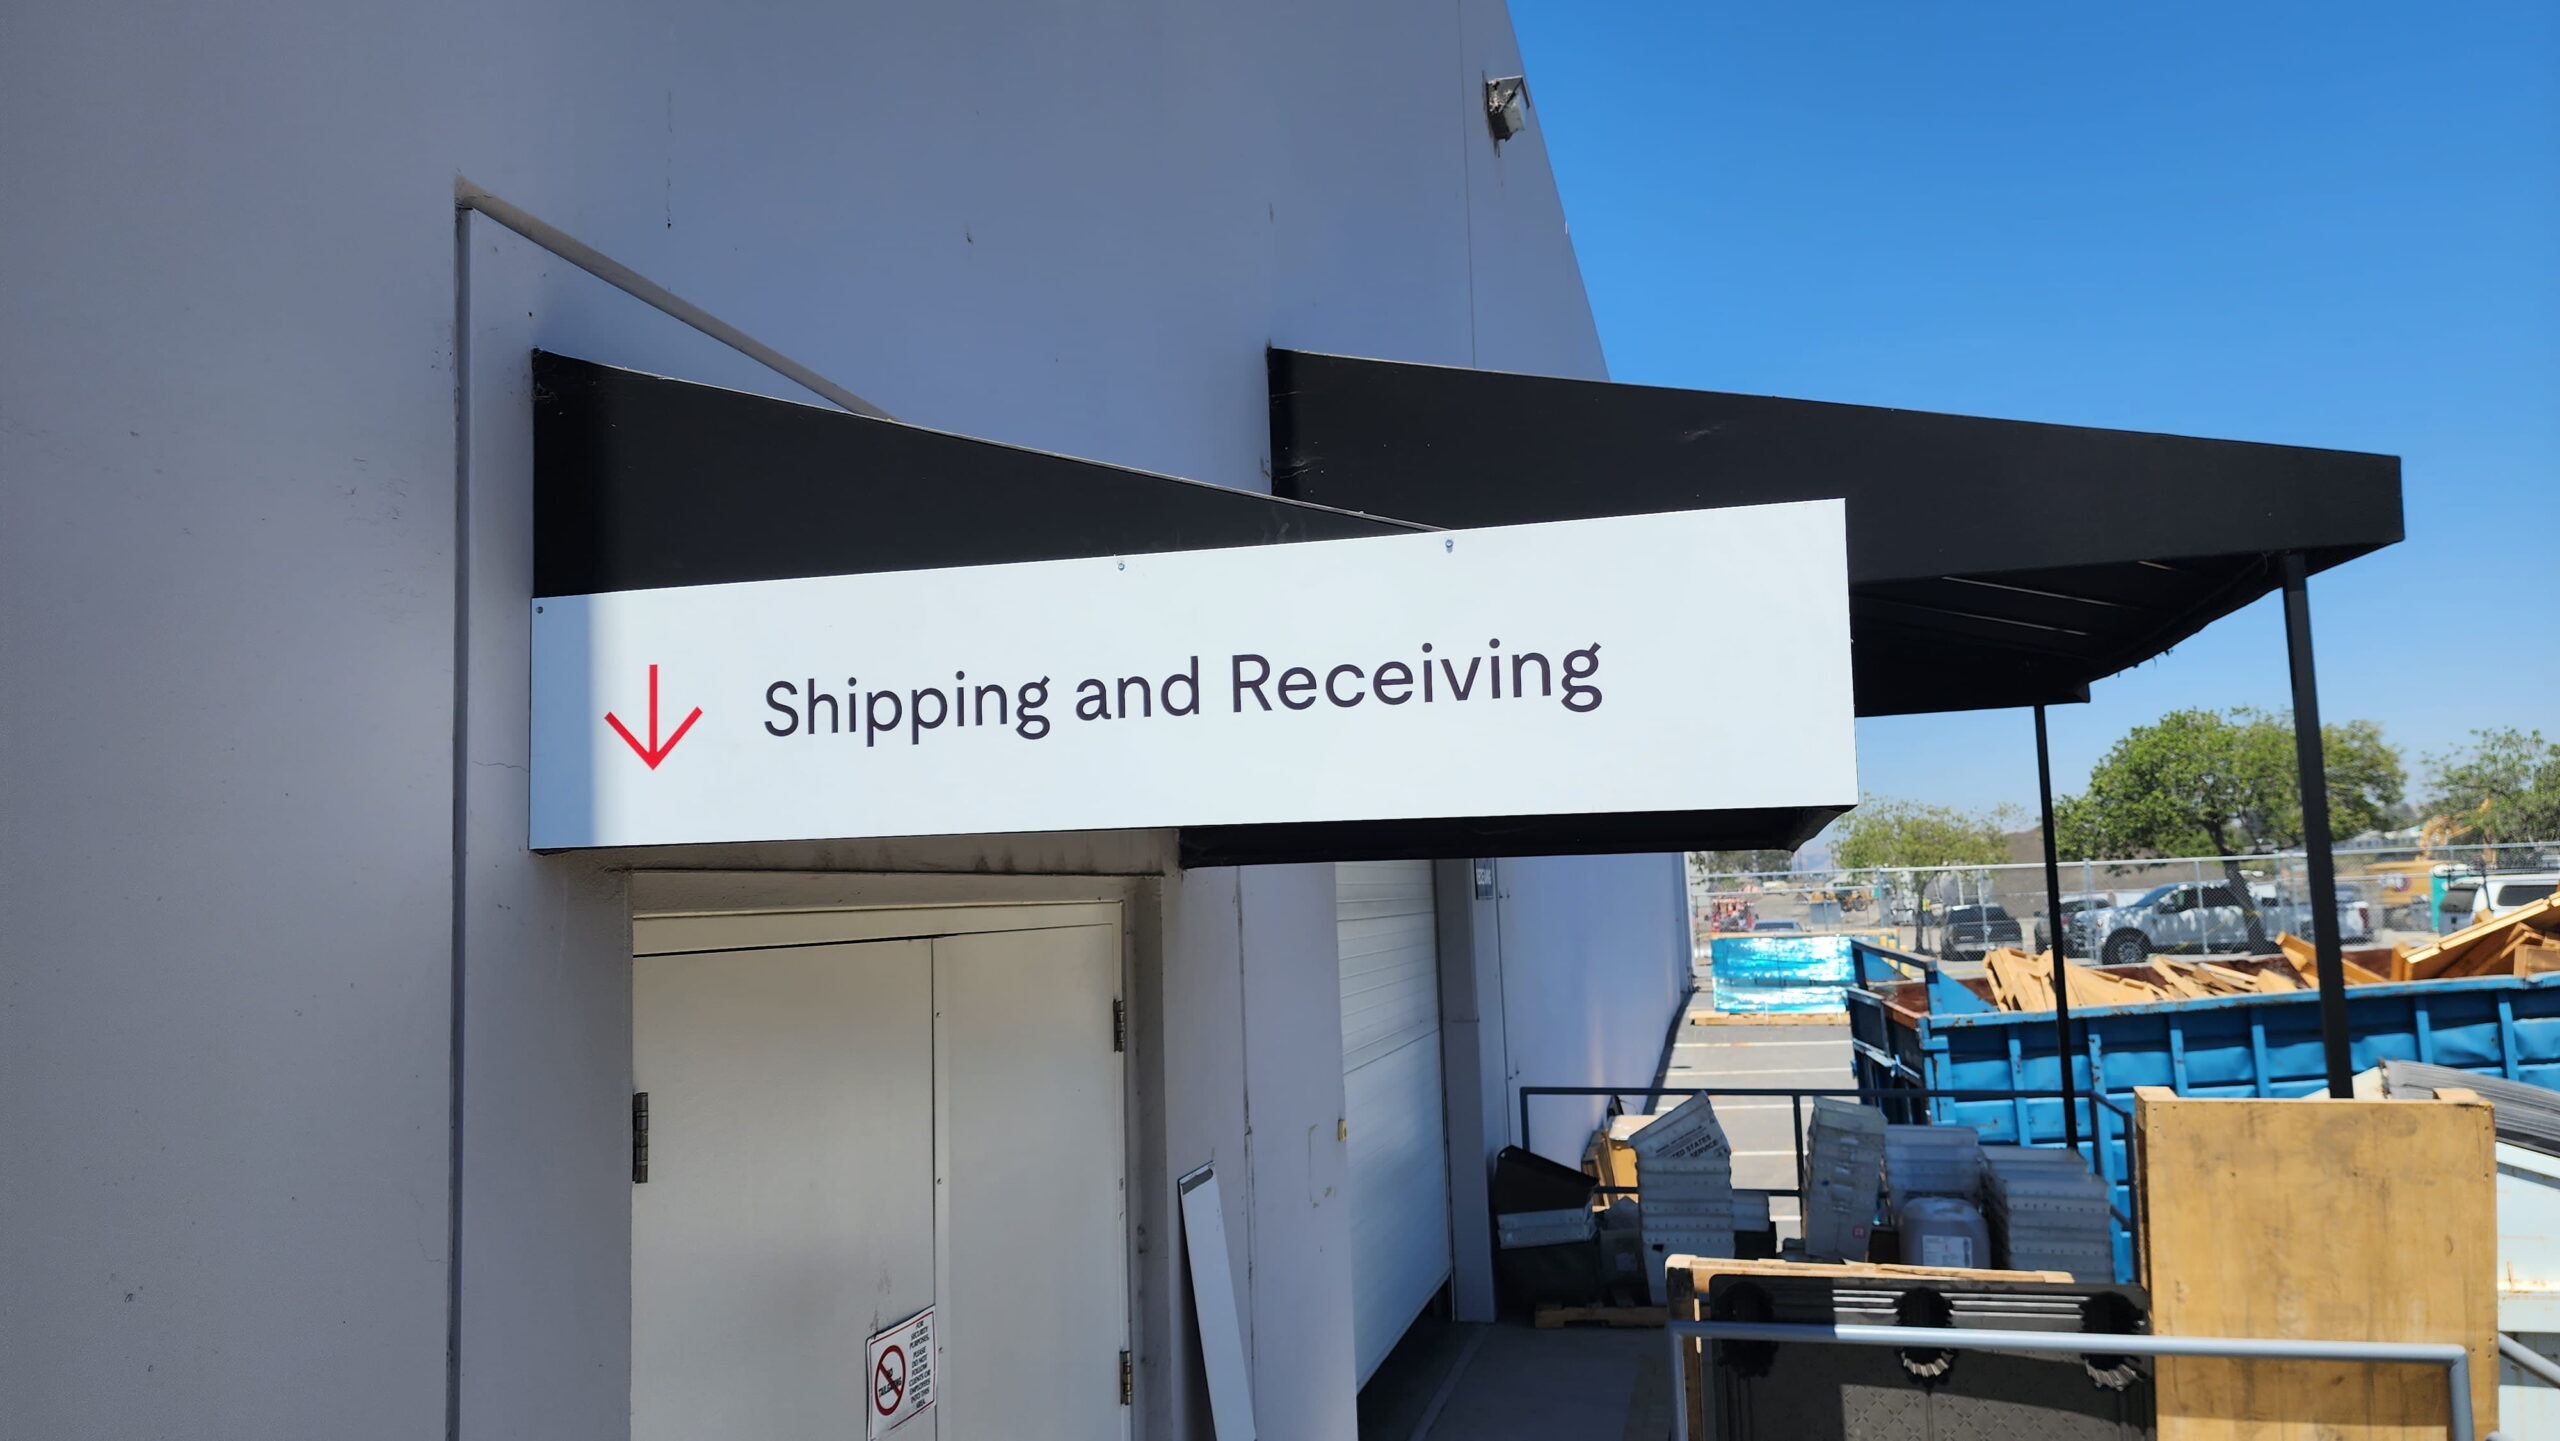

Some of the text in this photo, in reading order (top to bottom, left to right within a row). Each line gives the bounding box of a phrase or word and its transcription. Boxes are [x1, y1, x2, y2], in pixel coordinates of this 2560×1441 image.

[765, 639, 1602, 747] Shipping and Receiving
